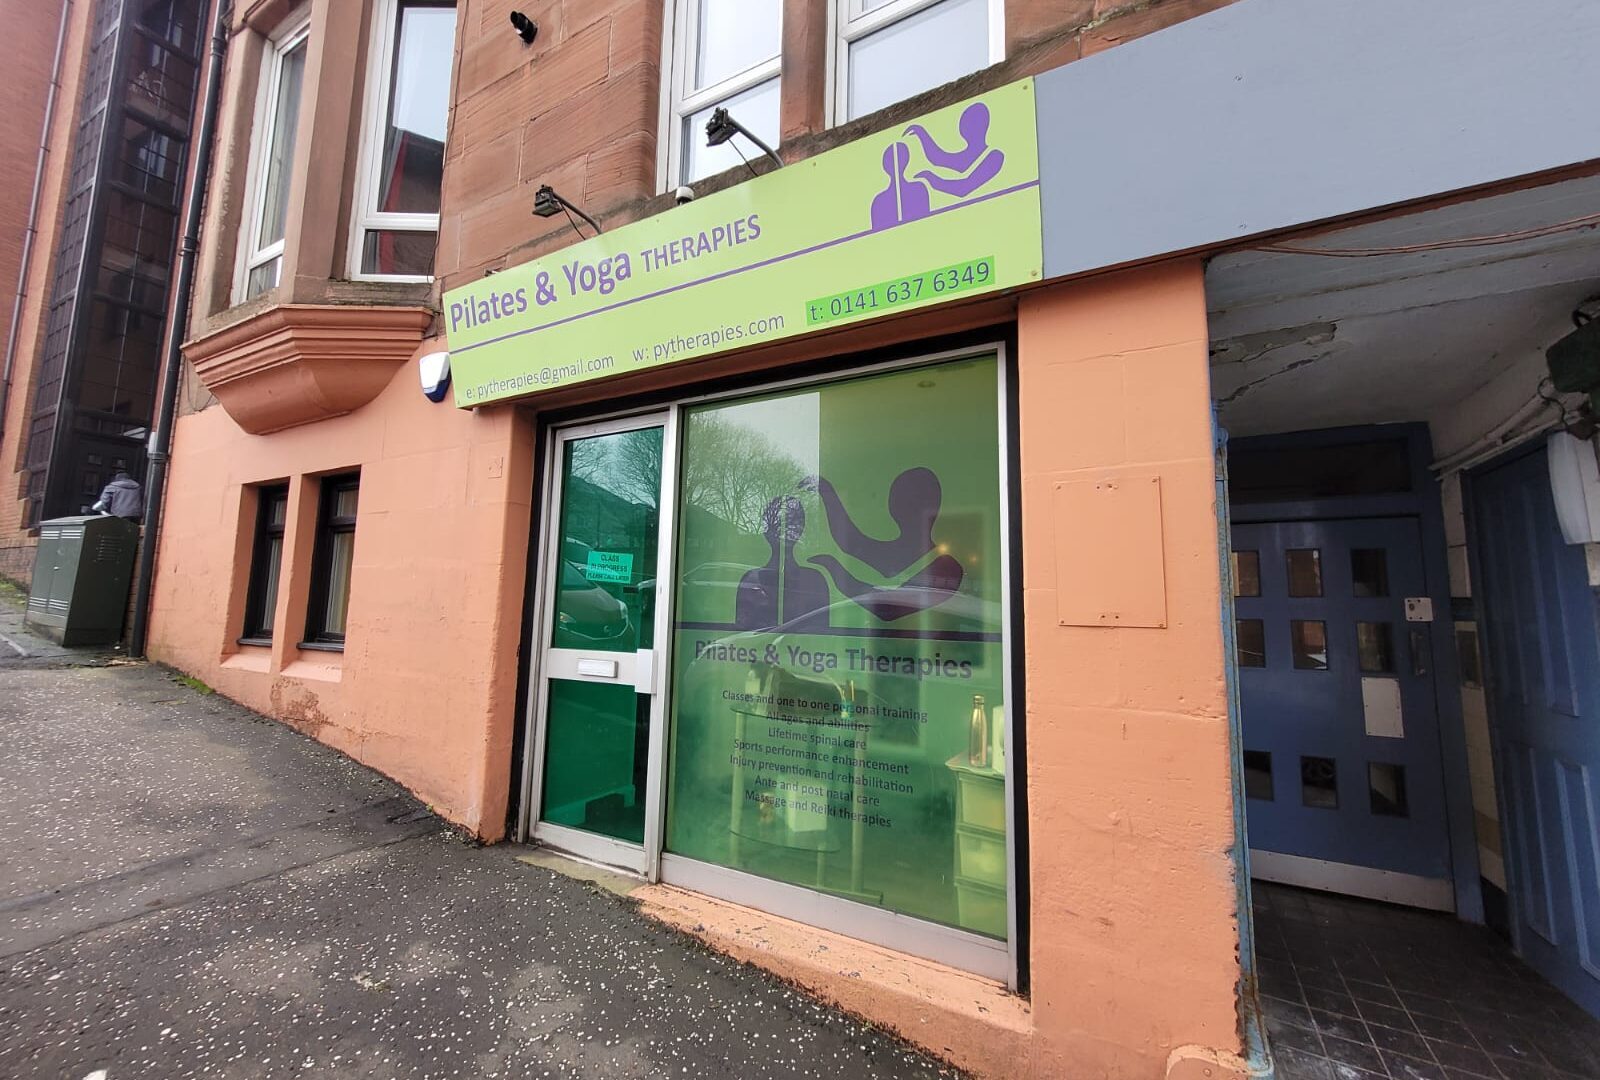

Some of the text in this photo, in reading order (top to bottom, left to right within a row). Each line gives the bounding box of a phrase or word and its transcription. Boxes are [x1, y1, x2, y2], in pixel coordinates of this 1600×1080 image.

[450, 214, 761, 333] Pilates & Yoga THERAPIES
[810, 261, 990, 321] t: 0141 637 6349
[466, 313, 785, 400] e: pytherapies@gmail.com w: pytherapies.com
[695, 640, 973, 680] Pilates & Yoga Therapies
[722, 690, 754, 702] Classes
[756, 694, 774, 704] and
[776, 697, 795, 707] one
[798, 698, 808, 708] to
[810, 700, 829, 711] one
[882, 706, 928, 723] training
[805, 716, 825, 727] and
[768, 727, 867, 750] Lifetime spinal care
[730, 755, 914, 794] Injury prevention and rehabilitation
[734, 739, 910, 775] Sports performance enhancement
[754, 775, 880, 807] Ante and post natal care
[789, 800, 808, 811] and
[810, 802, 836, 818] Reiki
[839, 808, 892, 828] therapies
